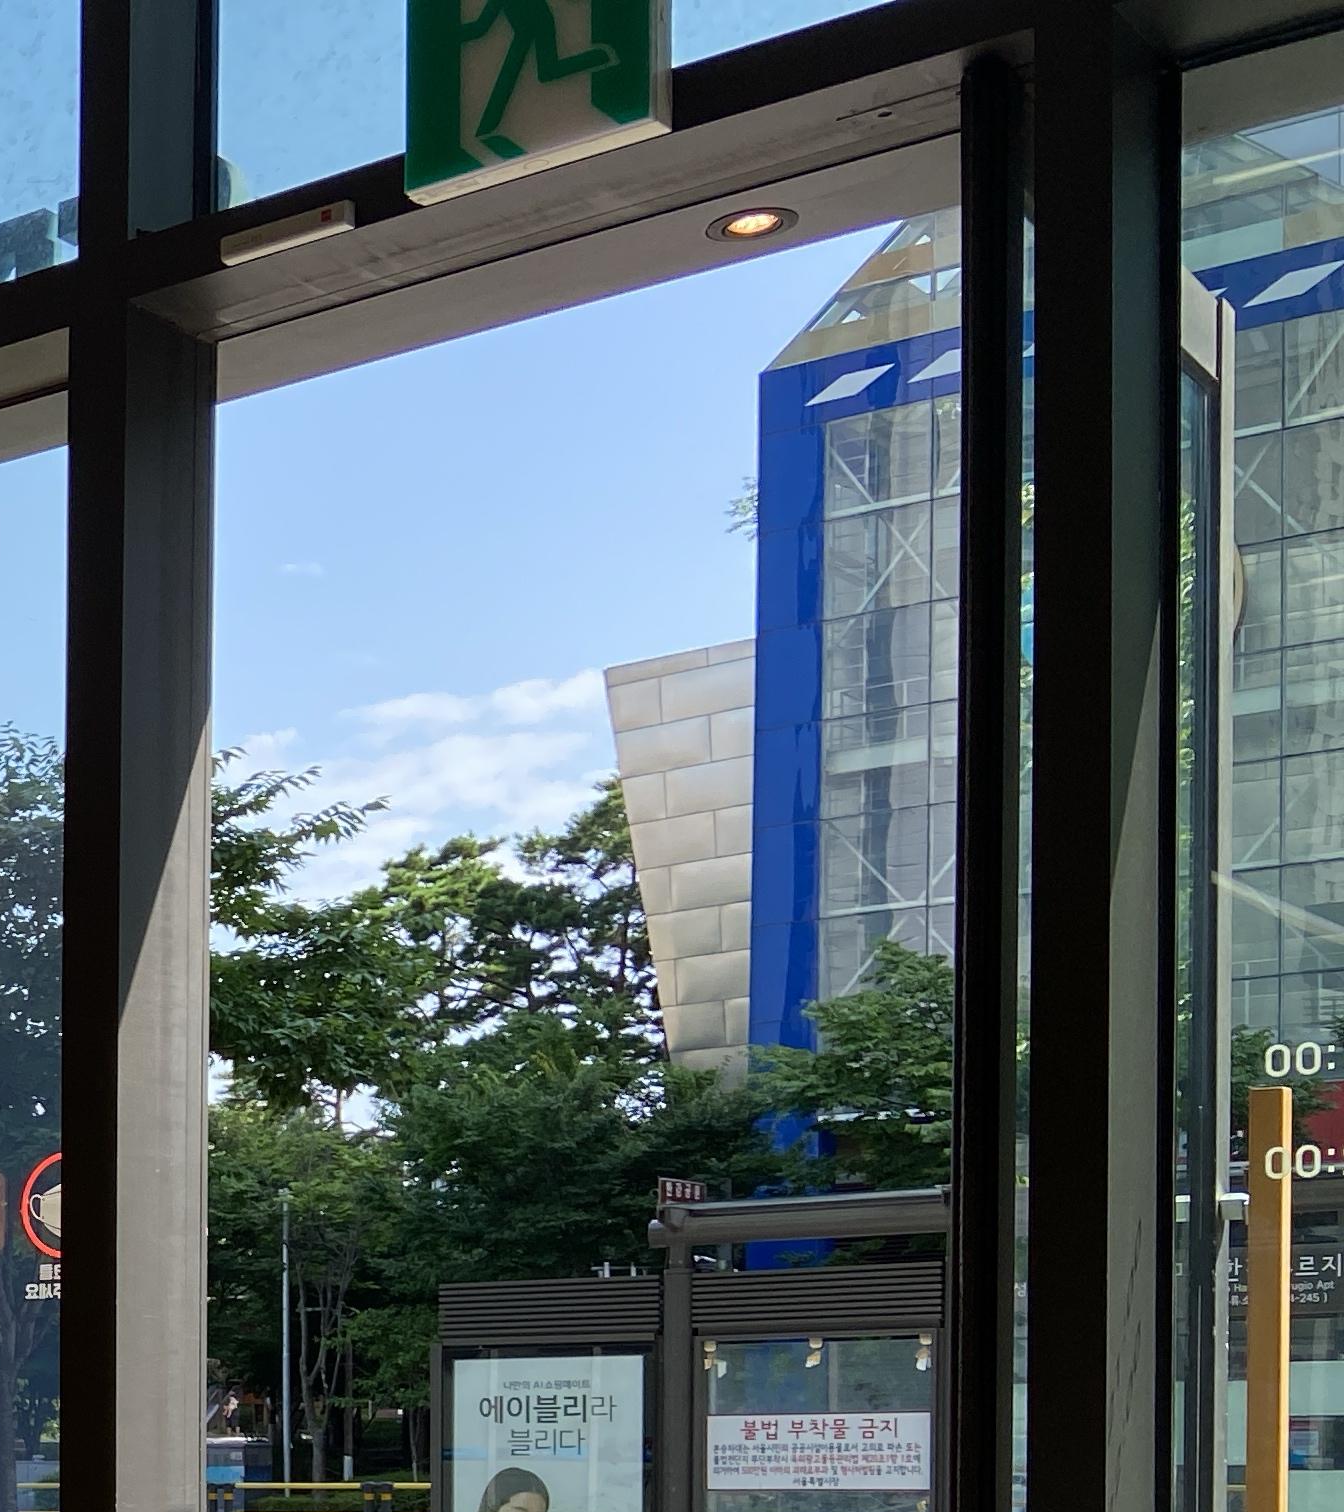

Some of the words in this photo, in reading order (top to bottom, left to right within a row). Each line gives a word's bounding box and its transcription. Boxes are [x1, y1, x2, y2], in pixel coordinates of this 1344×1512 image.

[1316, 1279, 1336, 1291] Apt
[479, 1394, 618, 1424] 에이블리라
[507, 1428, 586, 1456] 블리다
[740, 1419, 778, 1441] 불법
[787, 1418, 851, 1440] 부착물
[858, 1417, 898, 1439] 금지
